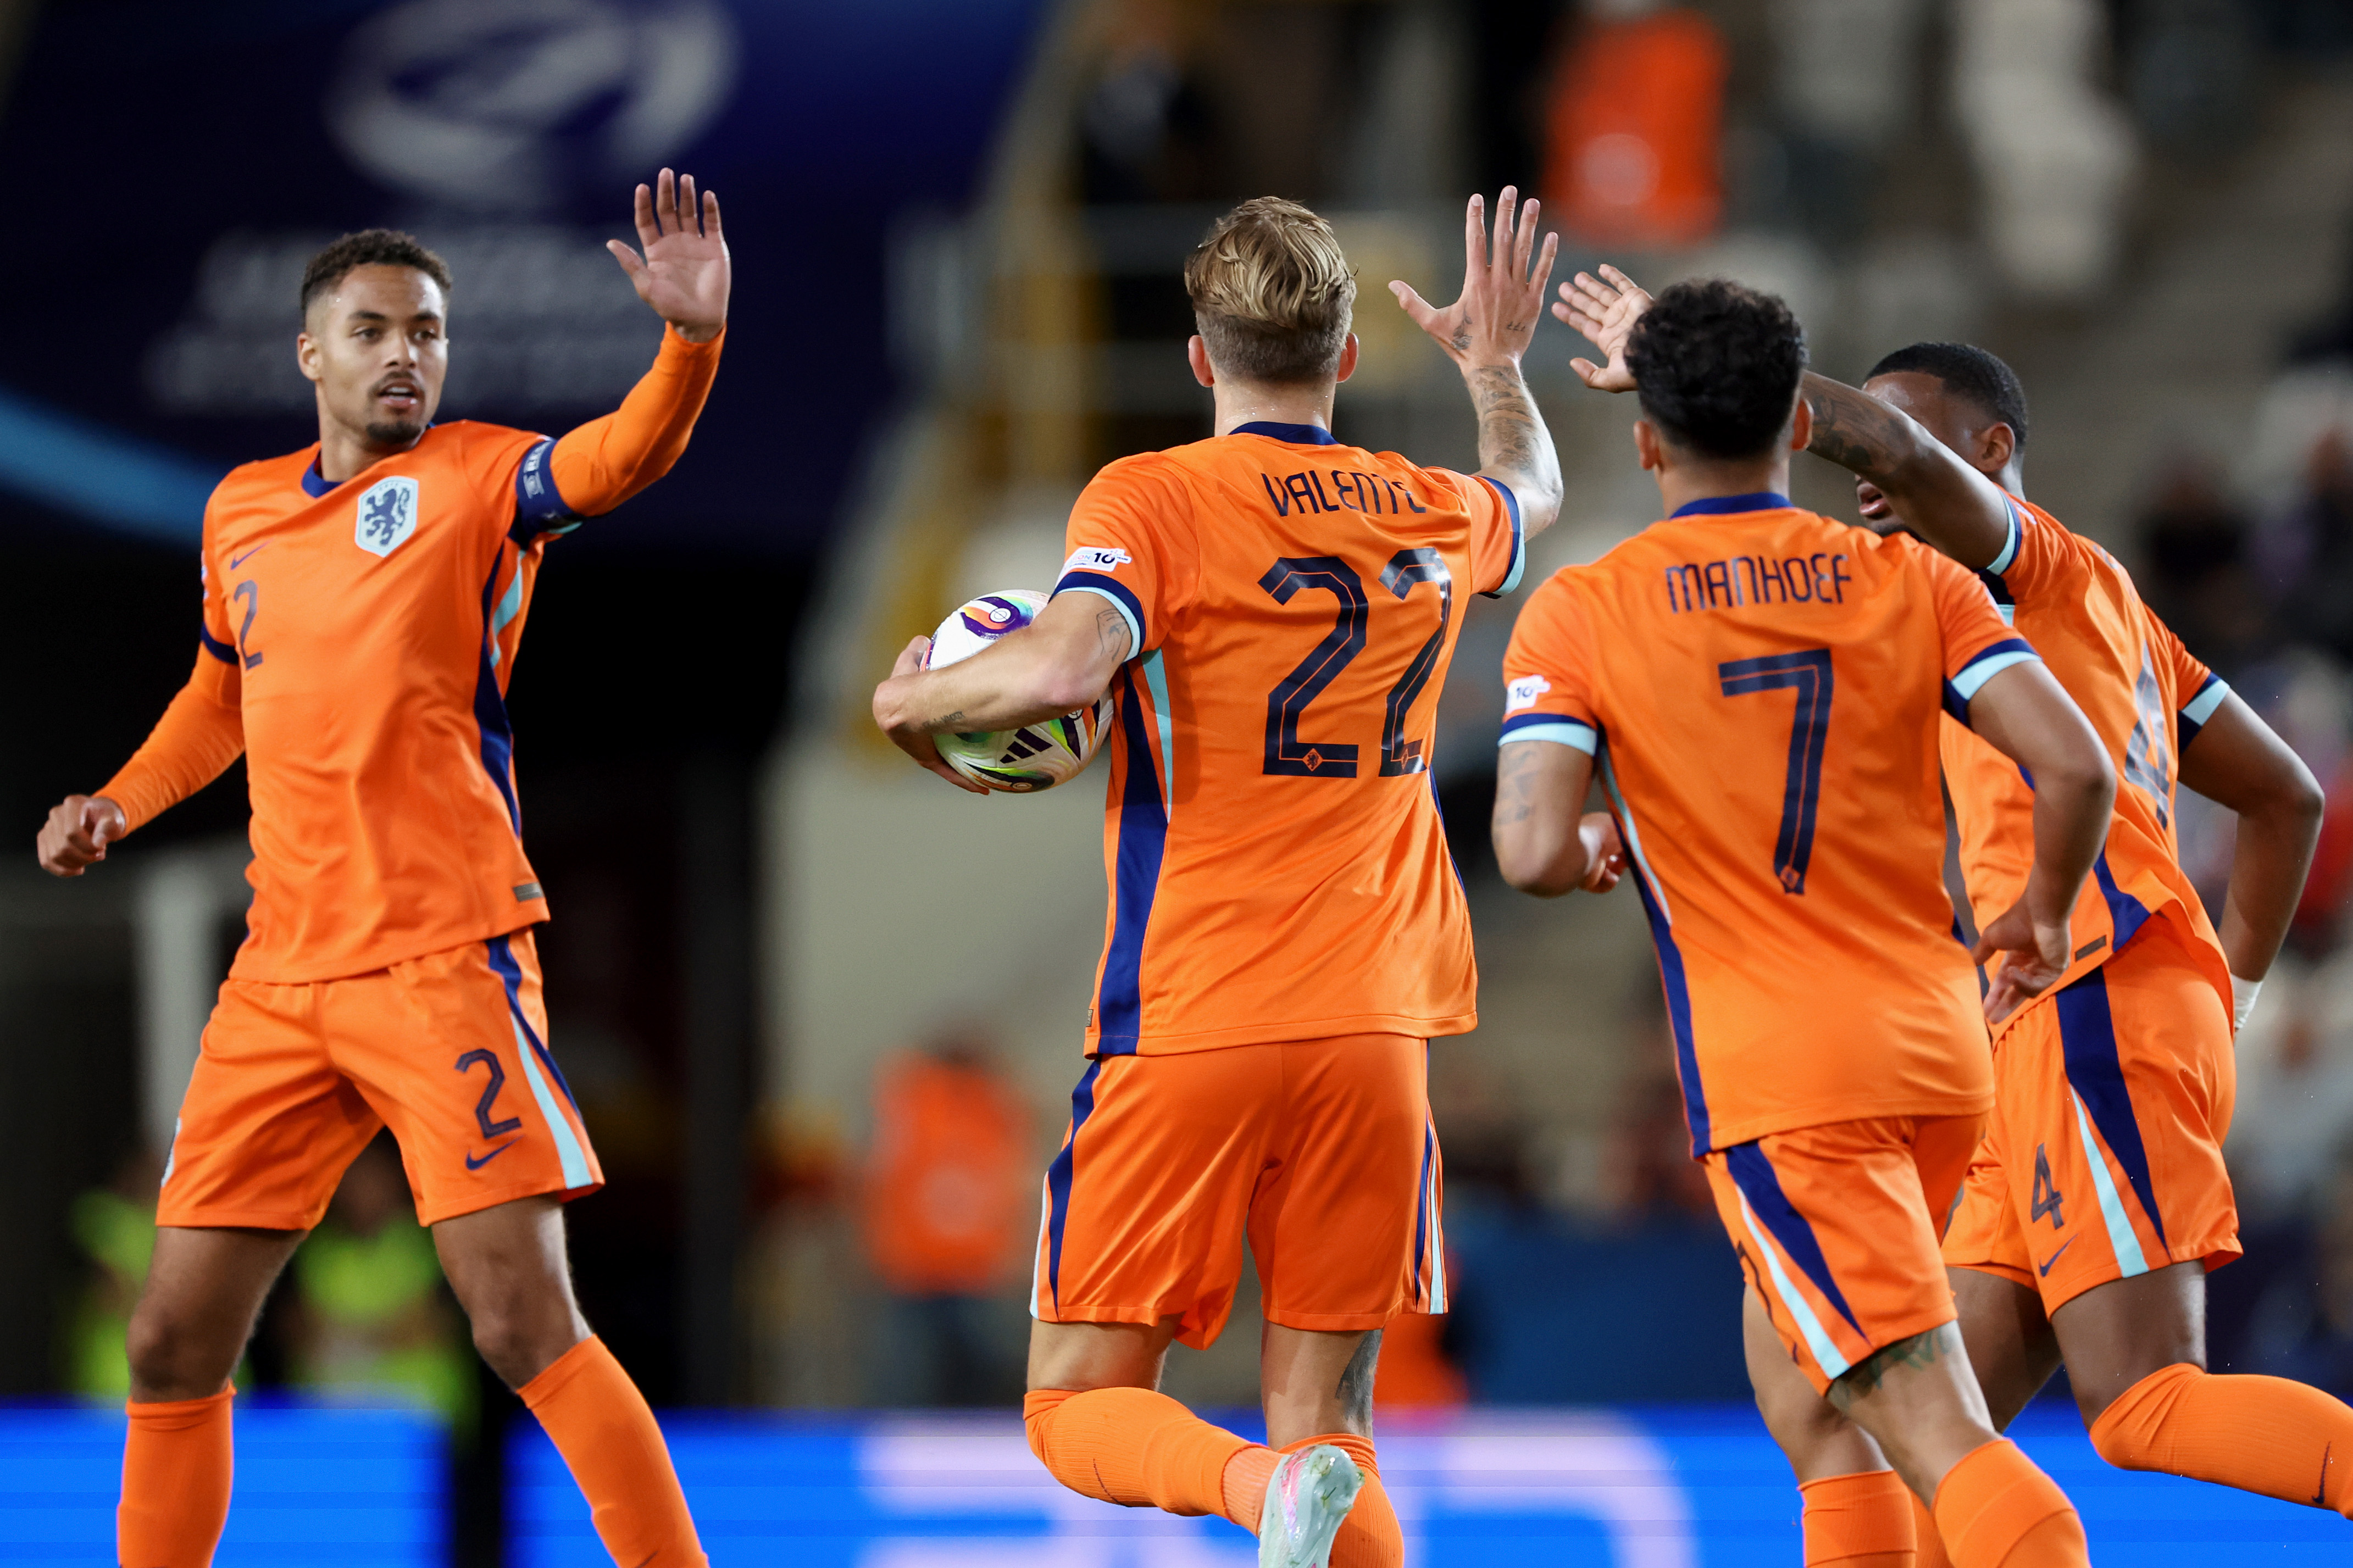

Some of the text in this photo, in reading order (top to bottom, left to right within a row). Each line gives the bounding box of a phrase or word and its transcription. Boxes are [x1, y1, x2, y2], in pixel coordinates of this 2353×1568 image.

[233, 580, 263, 671] 2
[1665, 554, 1852, 614] MANHOEF
[1257, 547, 1452, 779] 22
[1718, 648, 1834, 896] 7
[454, 1048, 522, 1139] 2
[2031, 1142, 2065, 1230] 4
